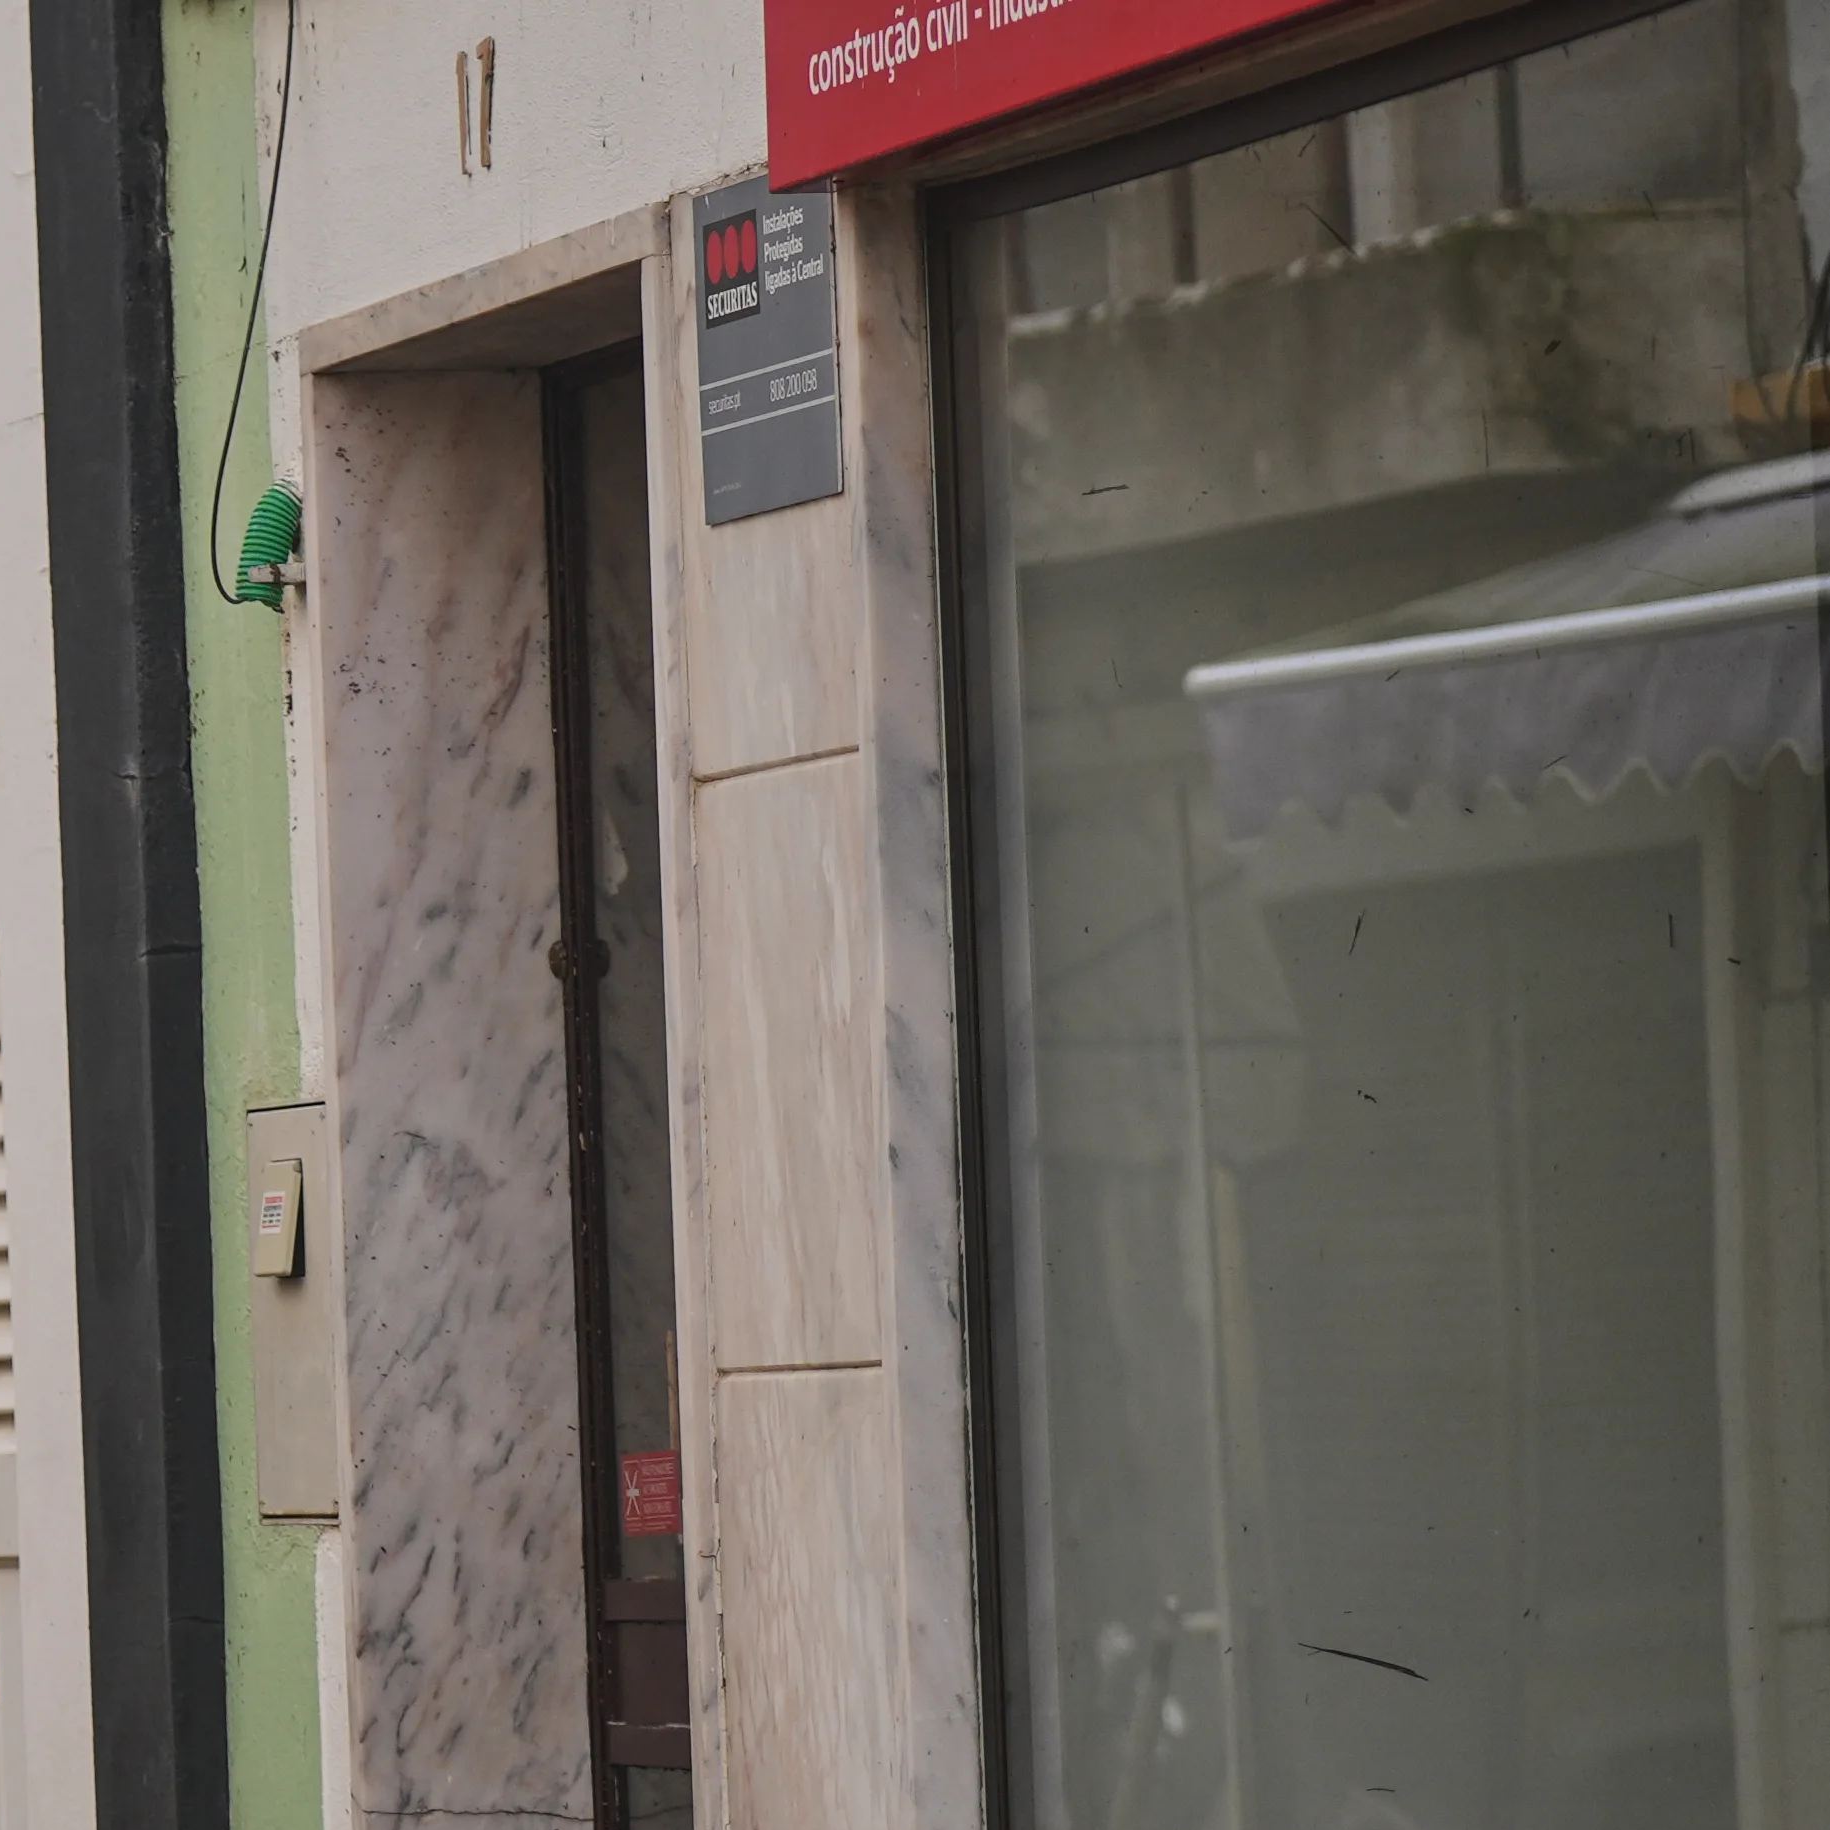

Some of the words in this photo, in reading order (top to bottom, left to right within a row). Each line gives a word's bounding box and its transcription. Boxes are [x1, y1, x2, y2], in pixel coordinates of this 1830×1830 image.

[808, 7, 921, 96] construção
[926, 0, 969, 53] civil
[762, 206, 804, 235] Instalações
[763, 234, 804, 263] Protegidas
[764, 265, 791, 295] ligadas
[791, 261, 797, 283] à
[797, 253, 824, 281] Central
[707, 281, 758, 320] SECURITAS
[769, 378, 786, 402] 808
[786, 373, 801, 398] 200
[801, 368, 818, 393] 098
